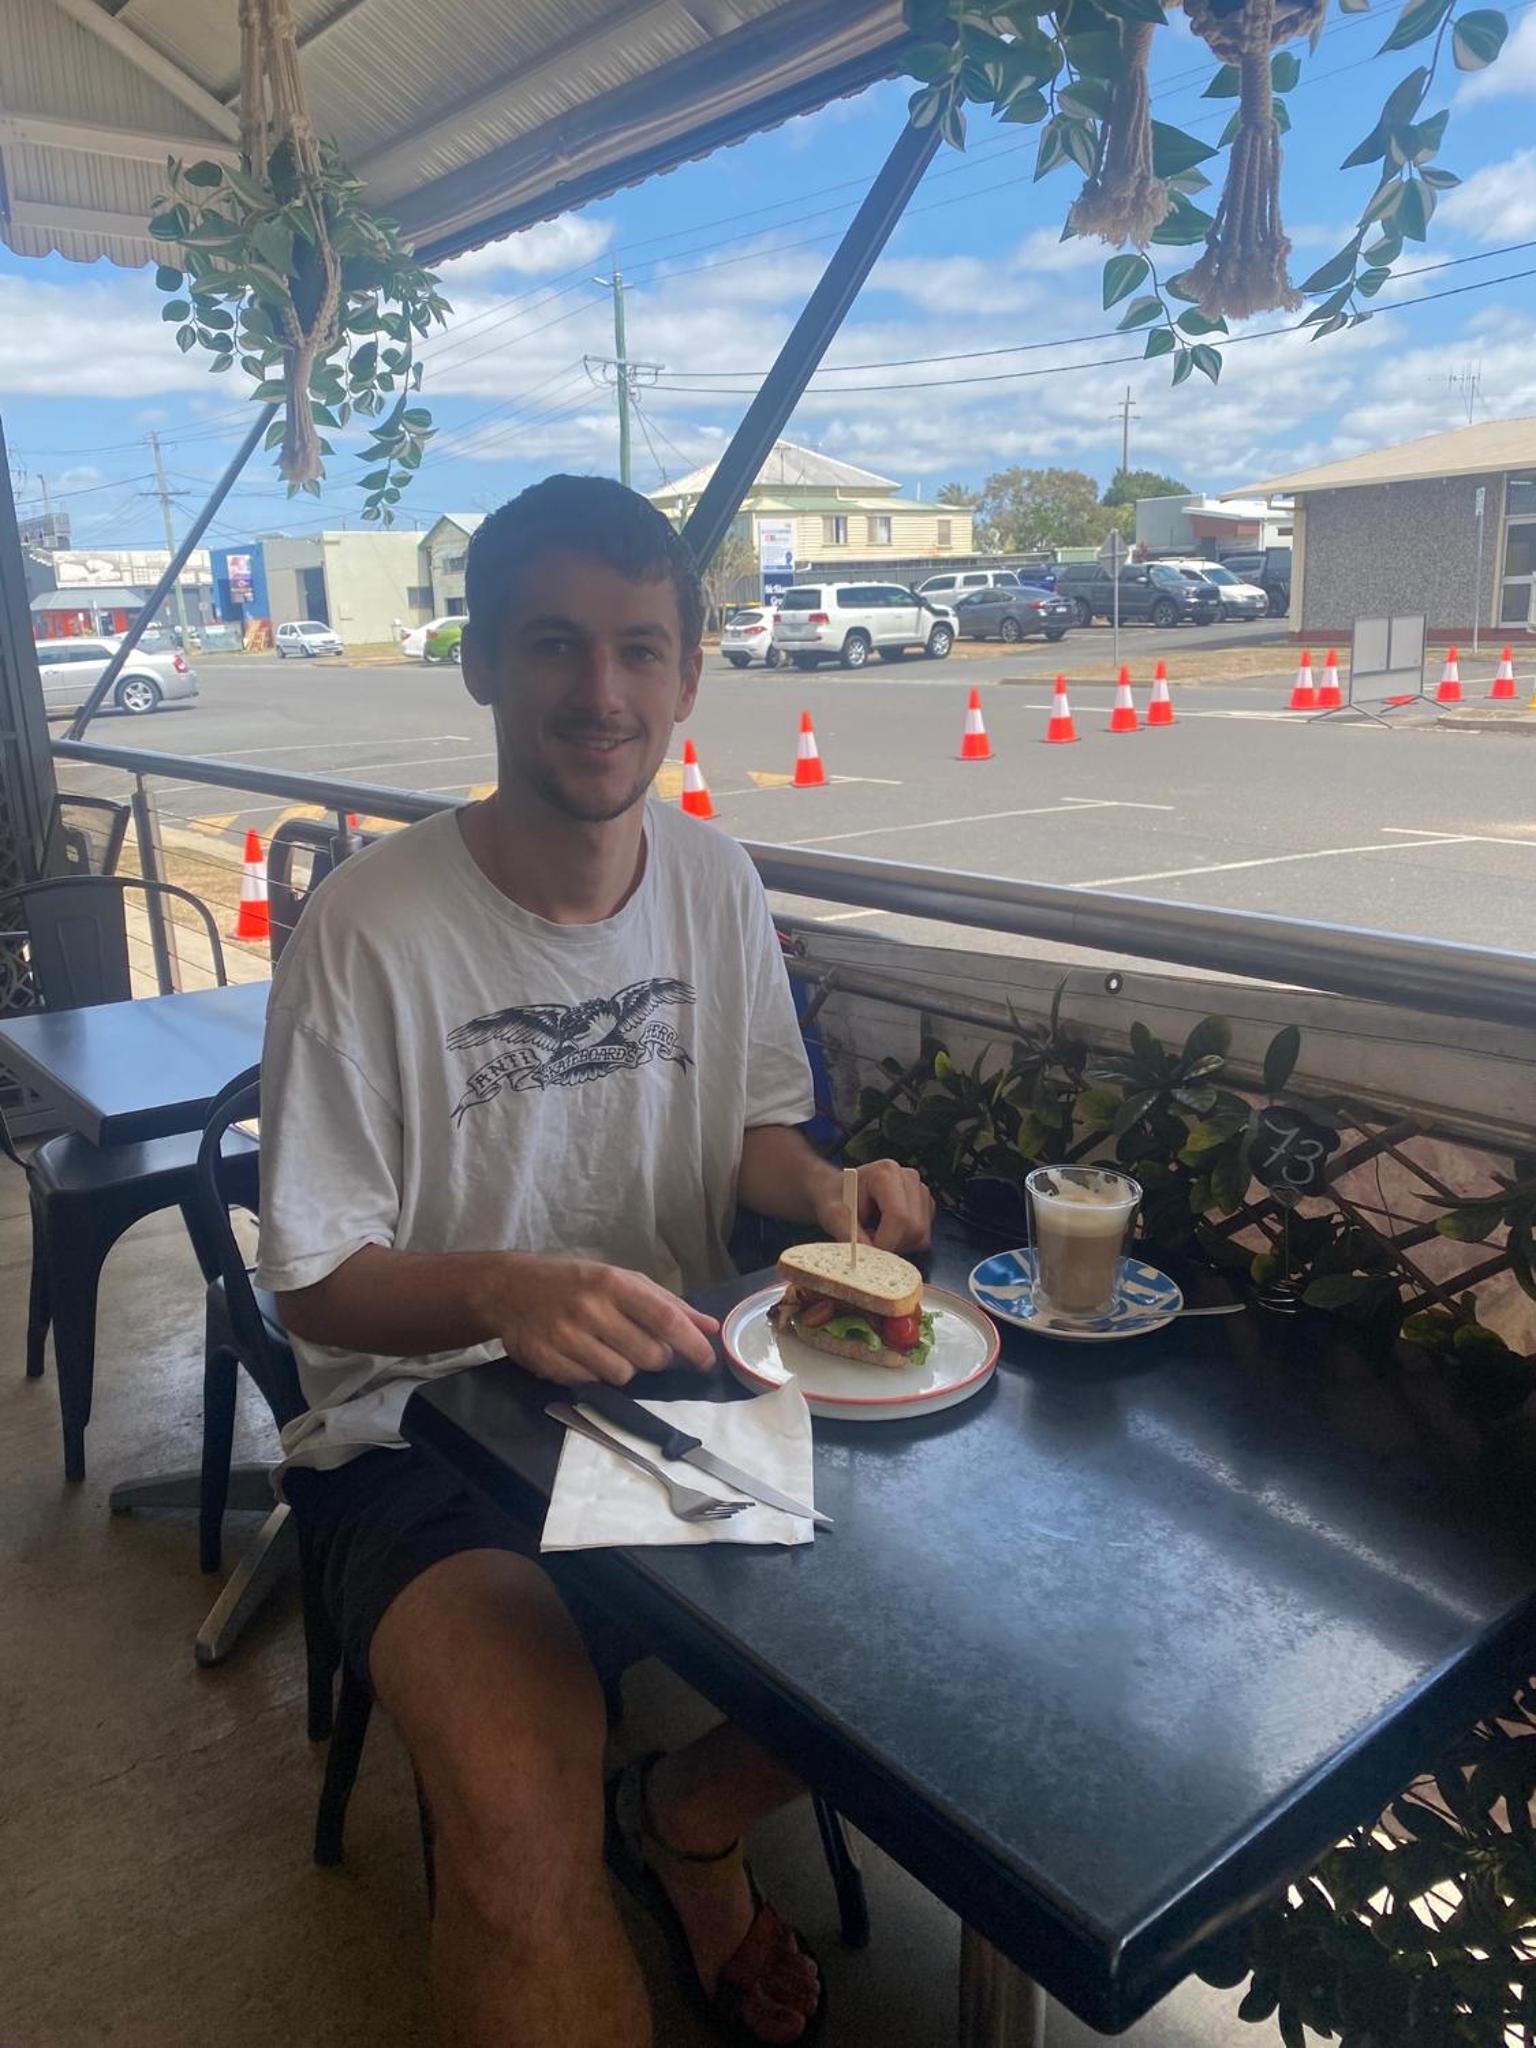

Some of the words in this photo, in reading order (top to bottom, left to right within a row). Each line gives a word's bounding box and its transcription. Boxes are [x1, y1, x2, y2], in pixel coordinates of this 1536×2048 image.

[474, 1051, 532, 1089] ANTI
[543, 1044, 638, 1082] SKATEBOARDS
[1262, 1118, 1325, 1185] 73
